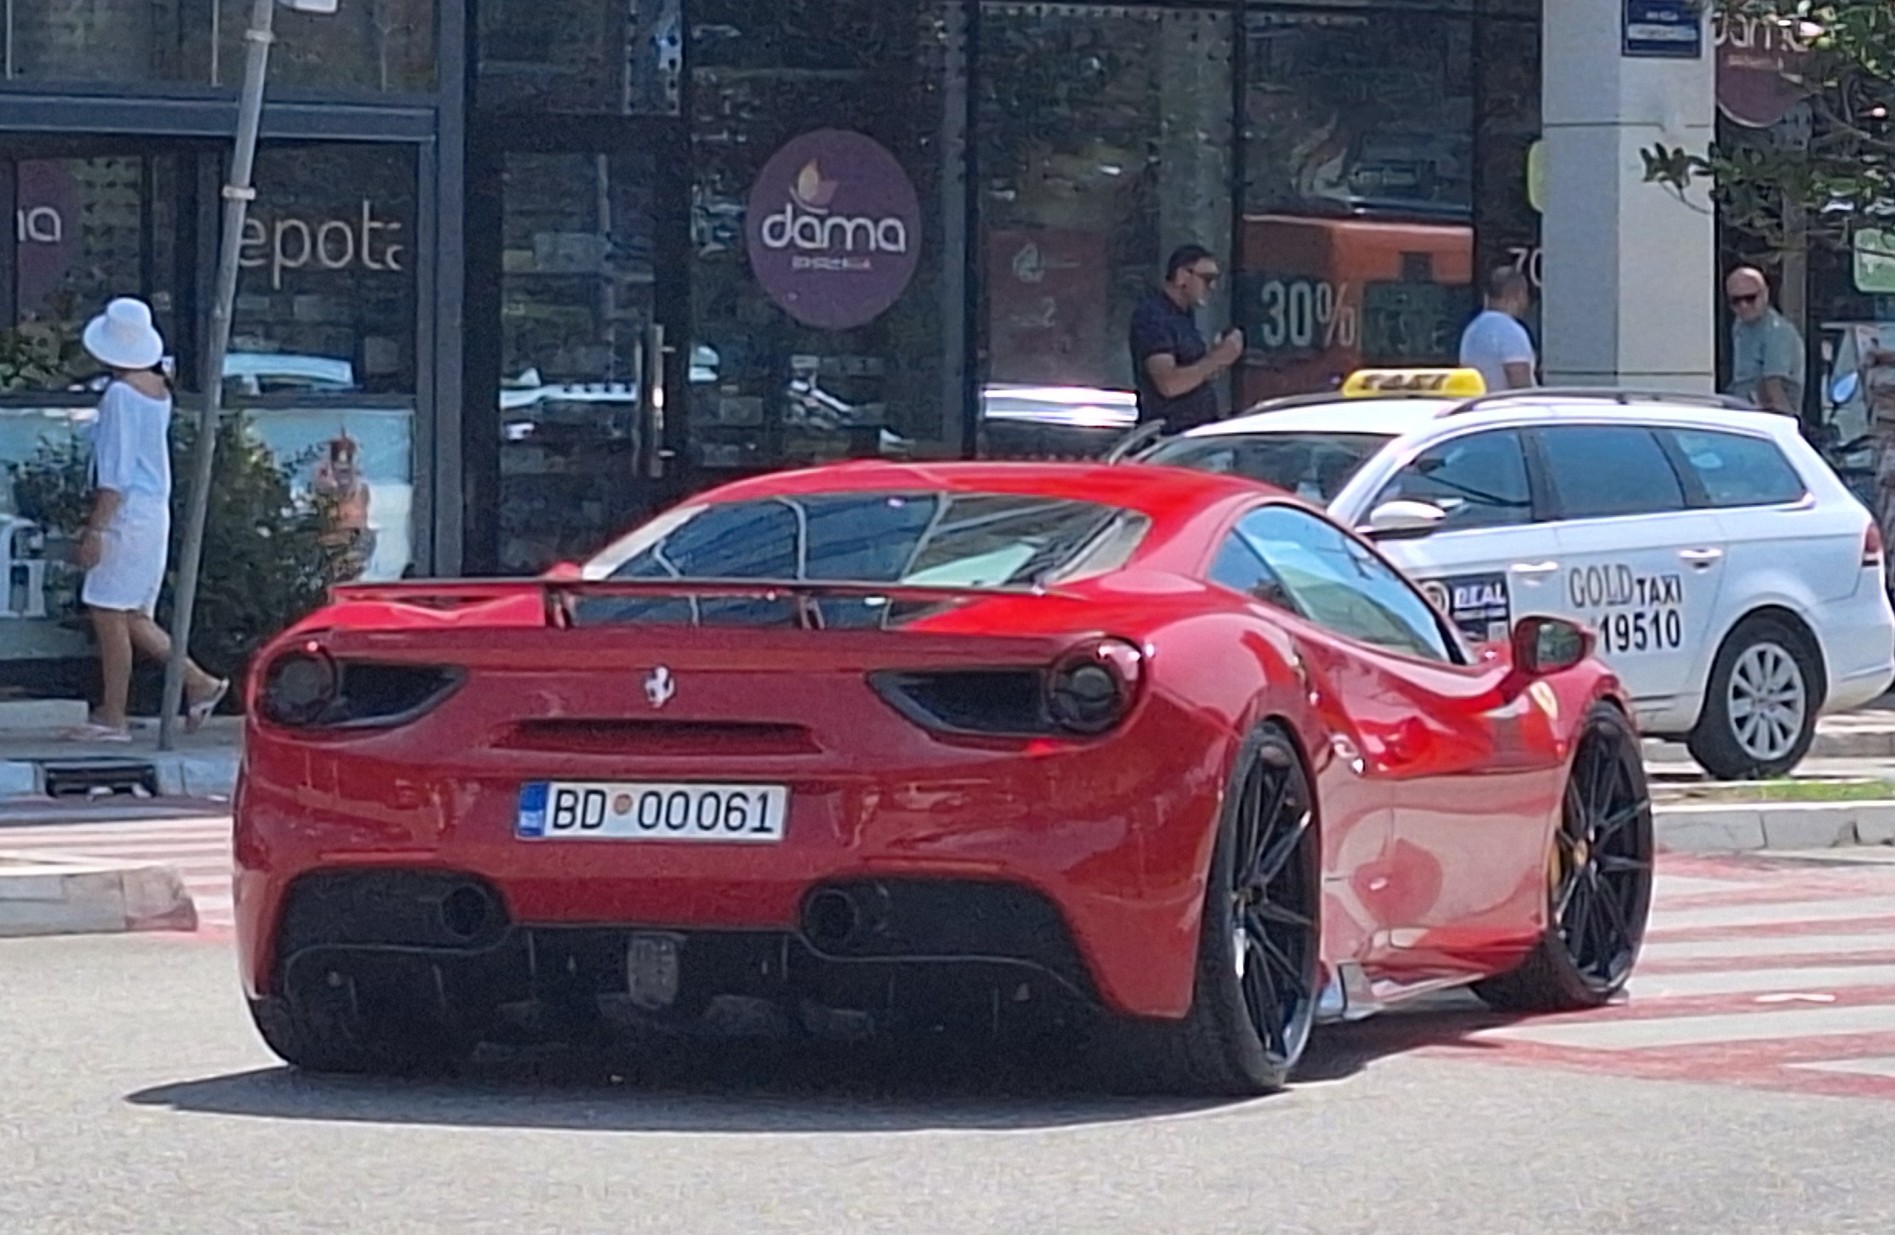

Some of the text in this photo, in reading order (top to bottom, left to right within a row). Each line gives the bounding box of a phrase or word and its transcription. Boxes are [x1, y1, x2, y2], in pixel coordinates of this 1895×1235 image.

[762, 202, 906, 252] dama
[1261, 280, 1356, 348] 30%
[1569, 563, 1682, 608] GOLD TAXI
[1599, 608, 1682, 654] 19510
[552, 788, 607, 831] BD
[636, 791, 774, 833] 00061
